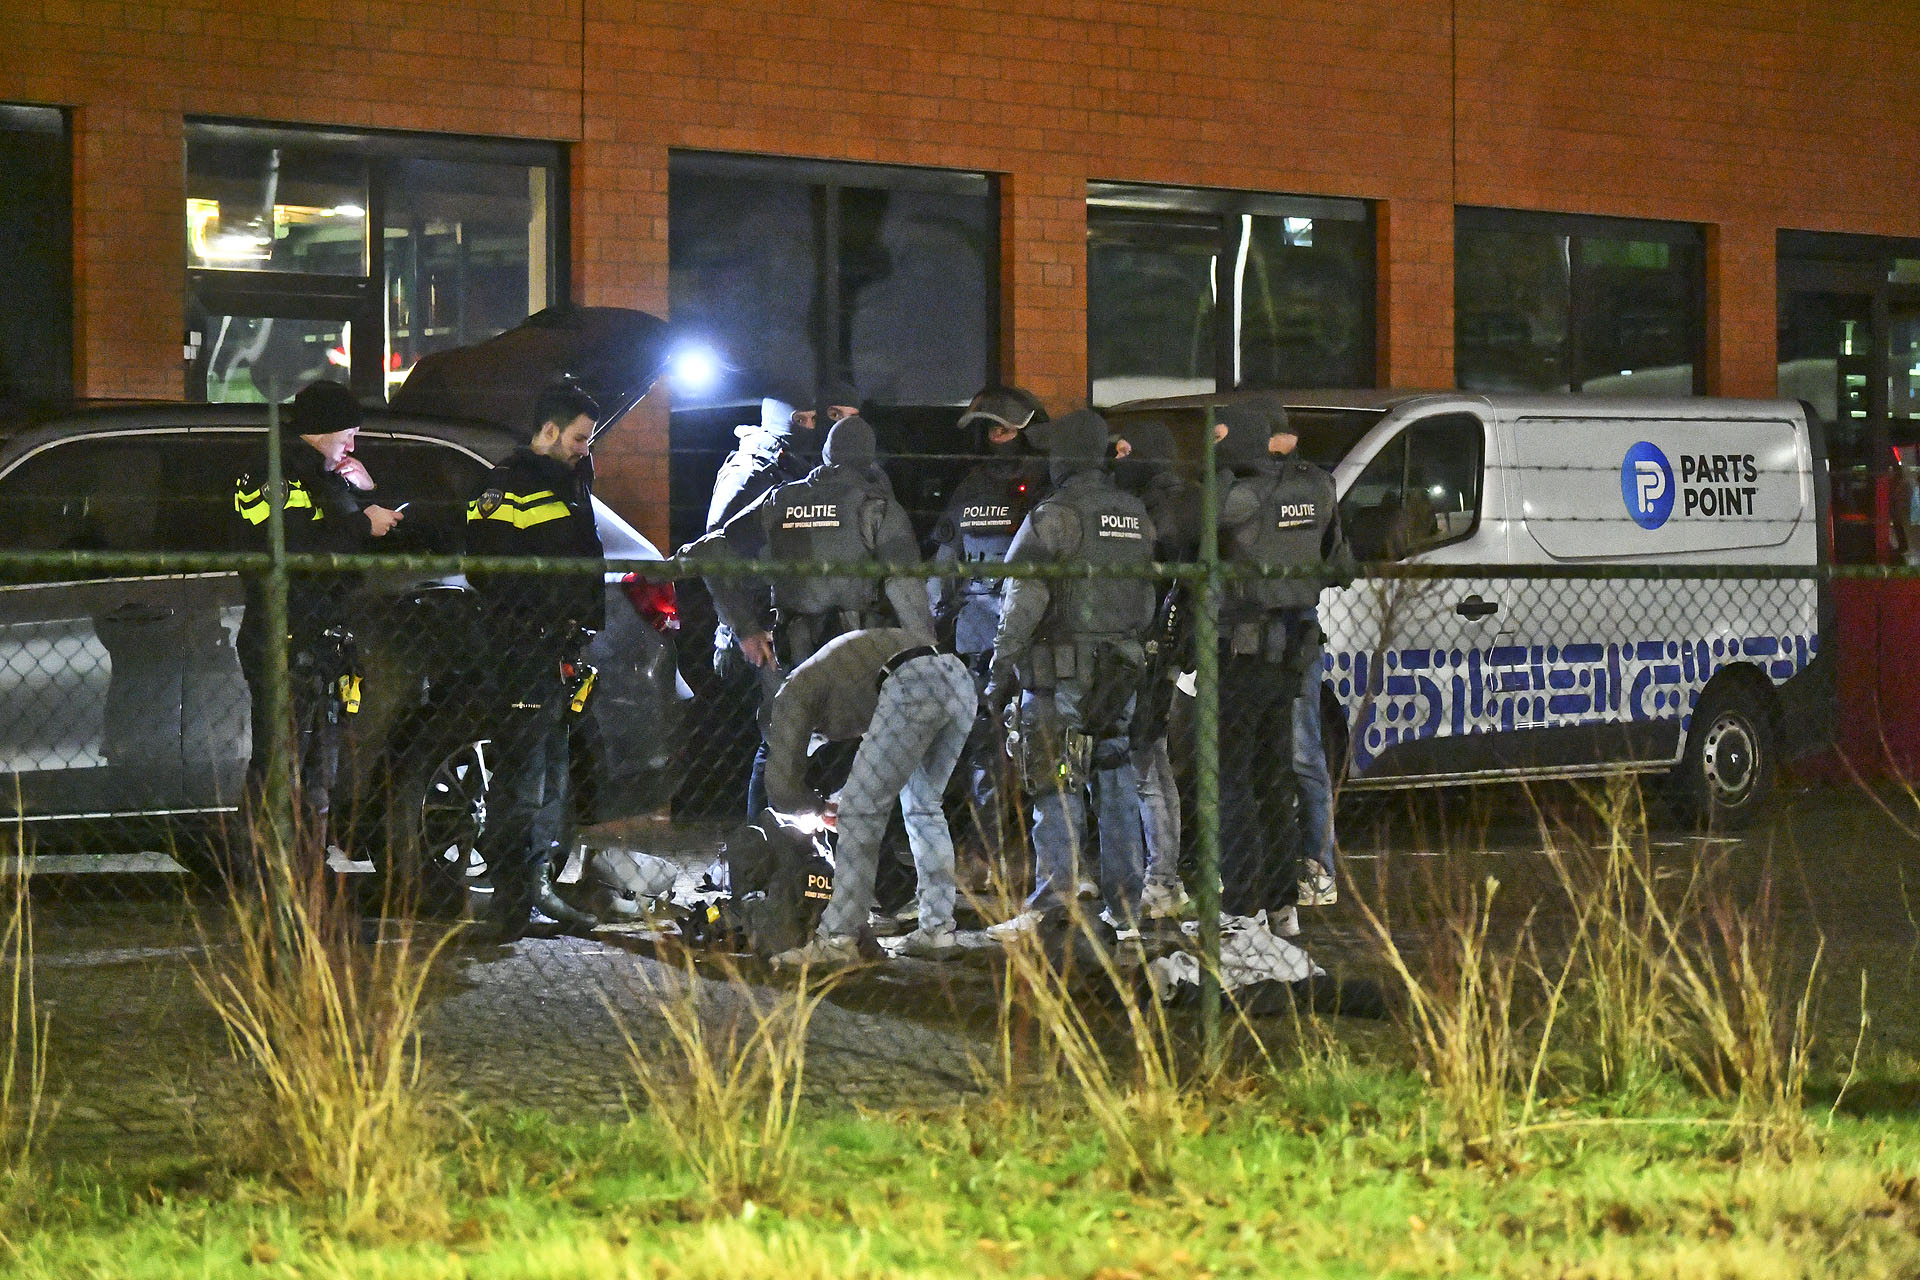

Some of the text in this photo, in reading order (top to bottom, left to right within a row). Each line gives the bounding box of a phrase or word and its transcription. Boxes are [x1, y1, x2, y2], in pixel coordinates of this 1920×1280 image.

[1680, 454, 1758, 483] PARTS
[1683, 487, 1757, 517] POINT
[786, 504, 837, 519] POLITIE
[963, 506, 1010, 518] POLITIE
[1281, 503, 1315, 518] POLITIE
[1101, 515, 1140, 530] POLITIE
[808, 874, 832, 890] POL
